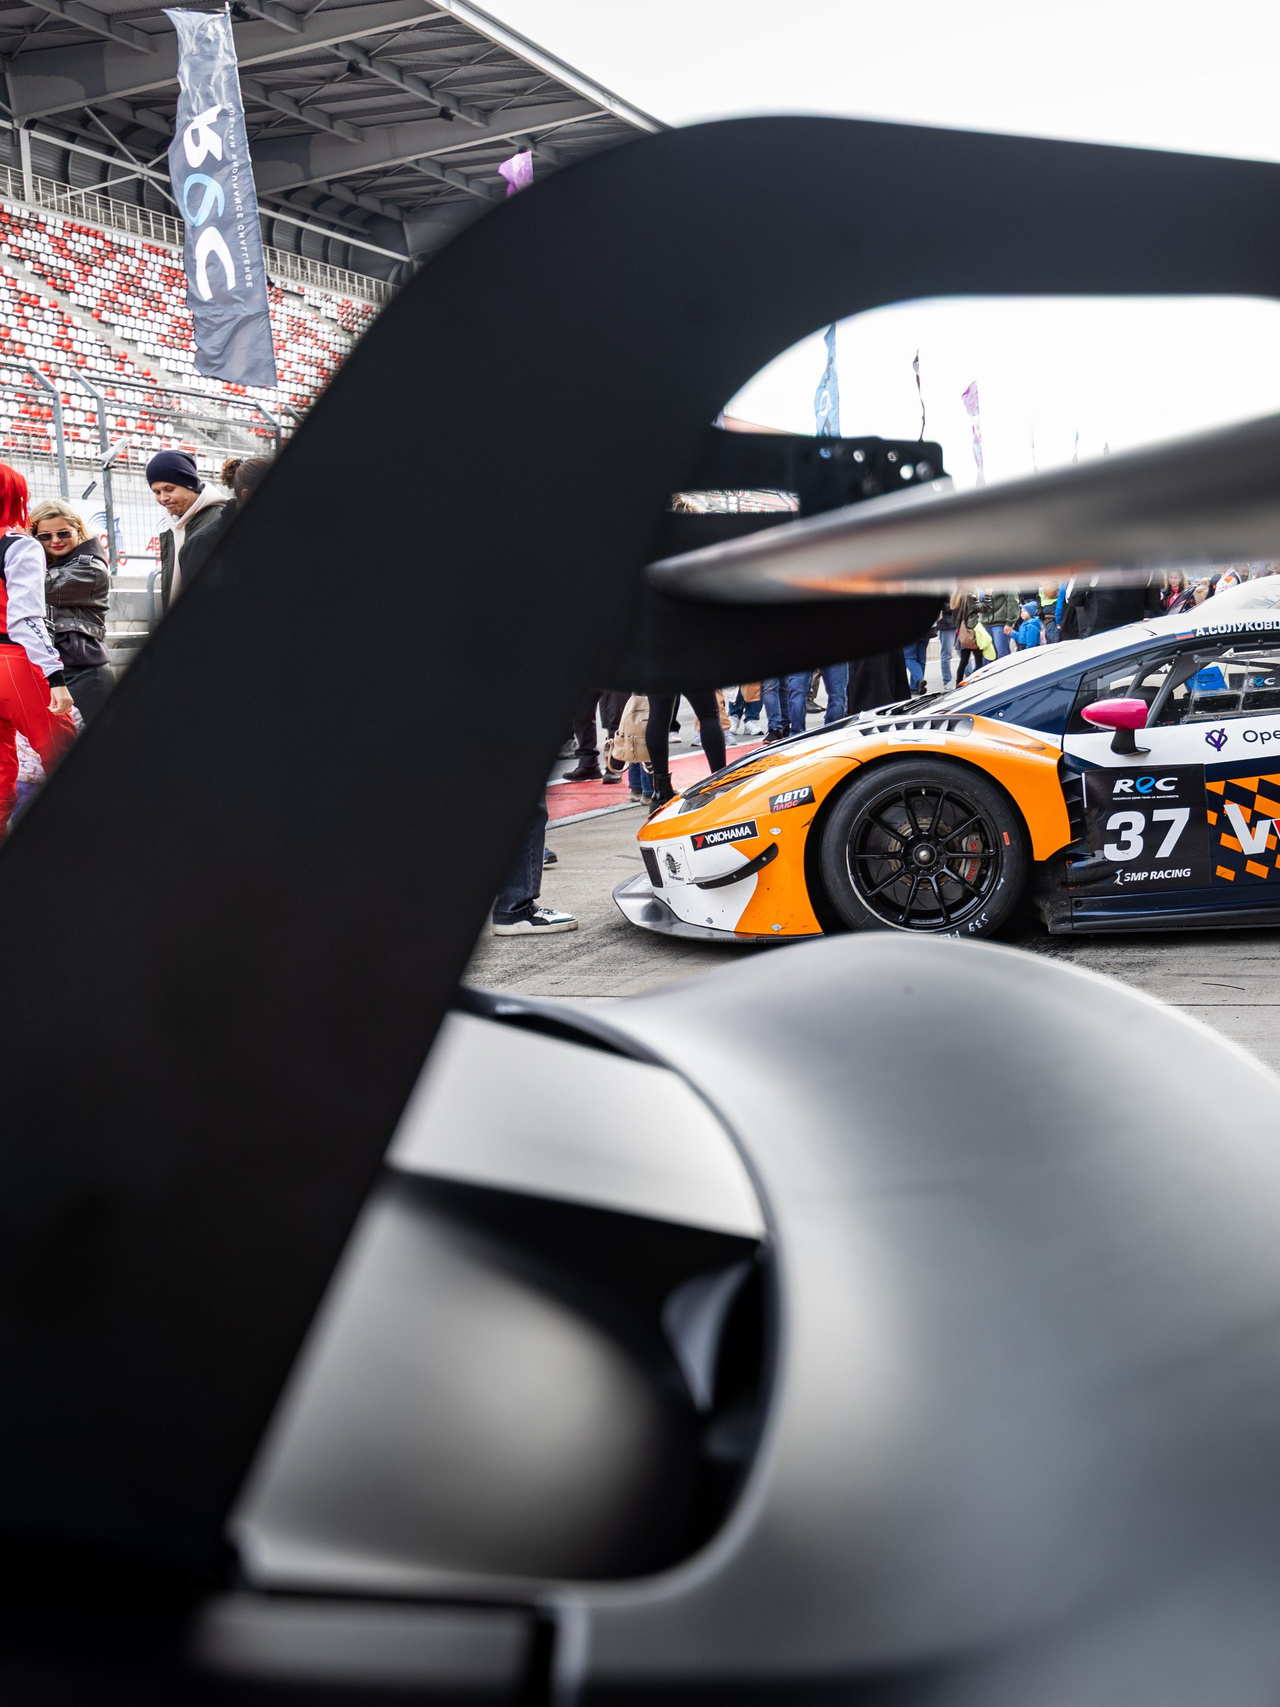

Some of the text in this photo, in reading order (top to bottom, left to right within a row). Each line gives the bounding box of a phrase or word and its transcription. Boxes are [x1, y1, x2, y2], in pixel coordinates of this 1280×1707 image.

[774, 787, 811, 806] АВТО
[704, 825, 752, 845] YOKOHAMA
[1104, 807, 1190, 862] 37
[1124, 868, 1191, 882] SMP RACING
